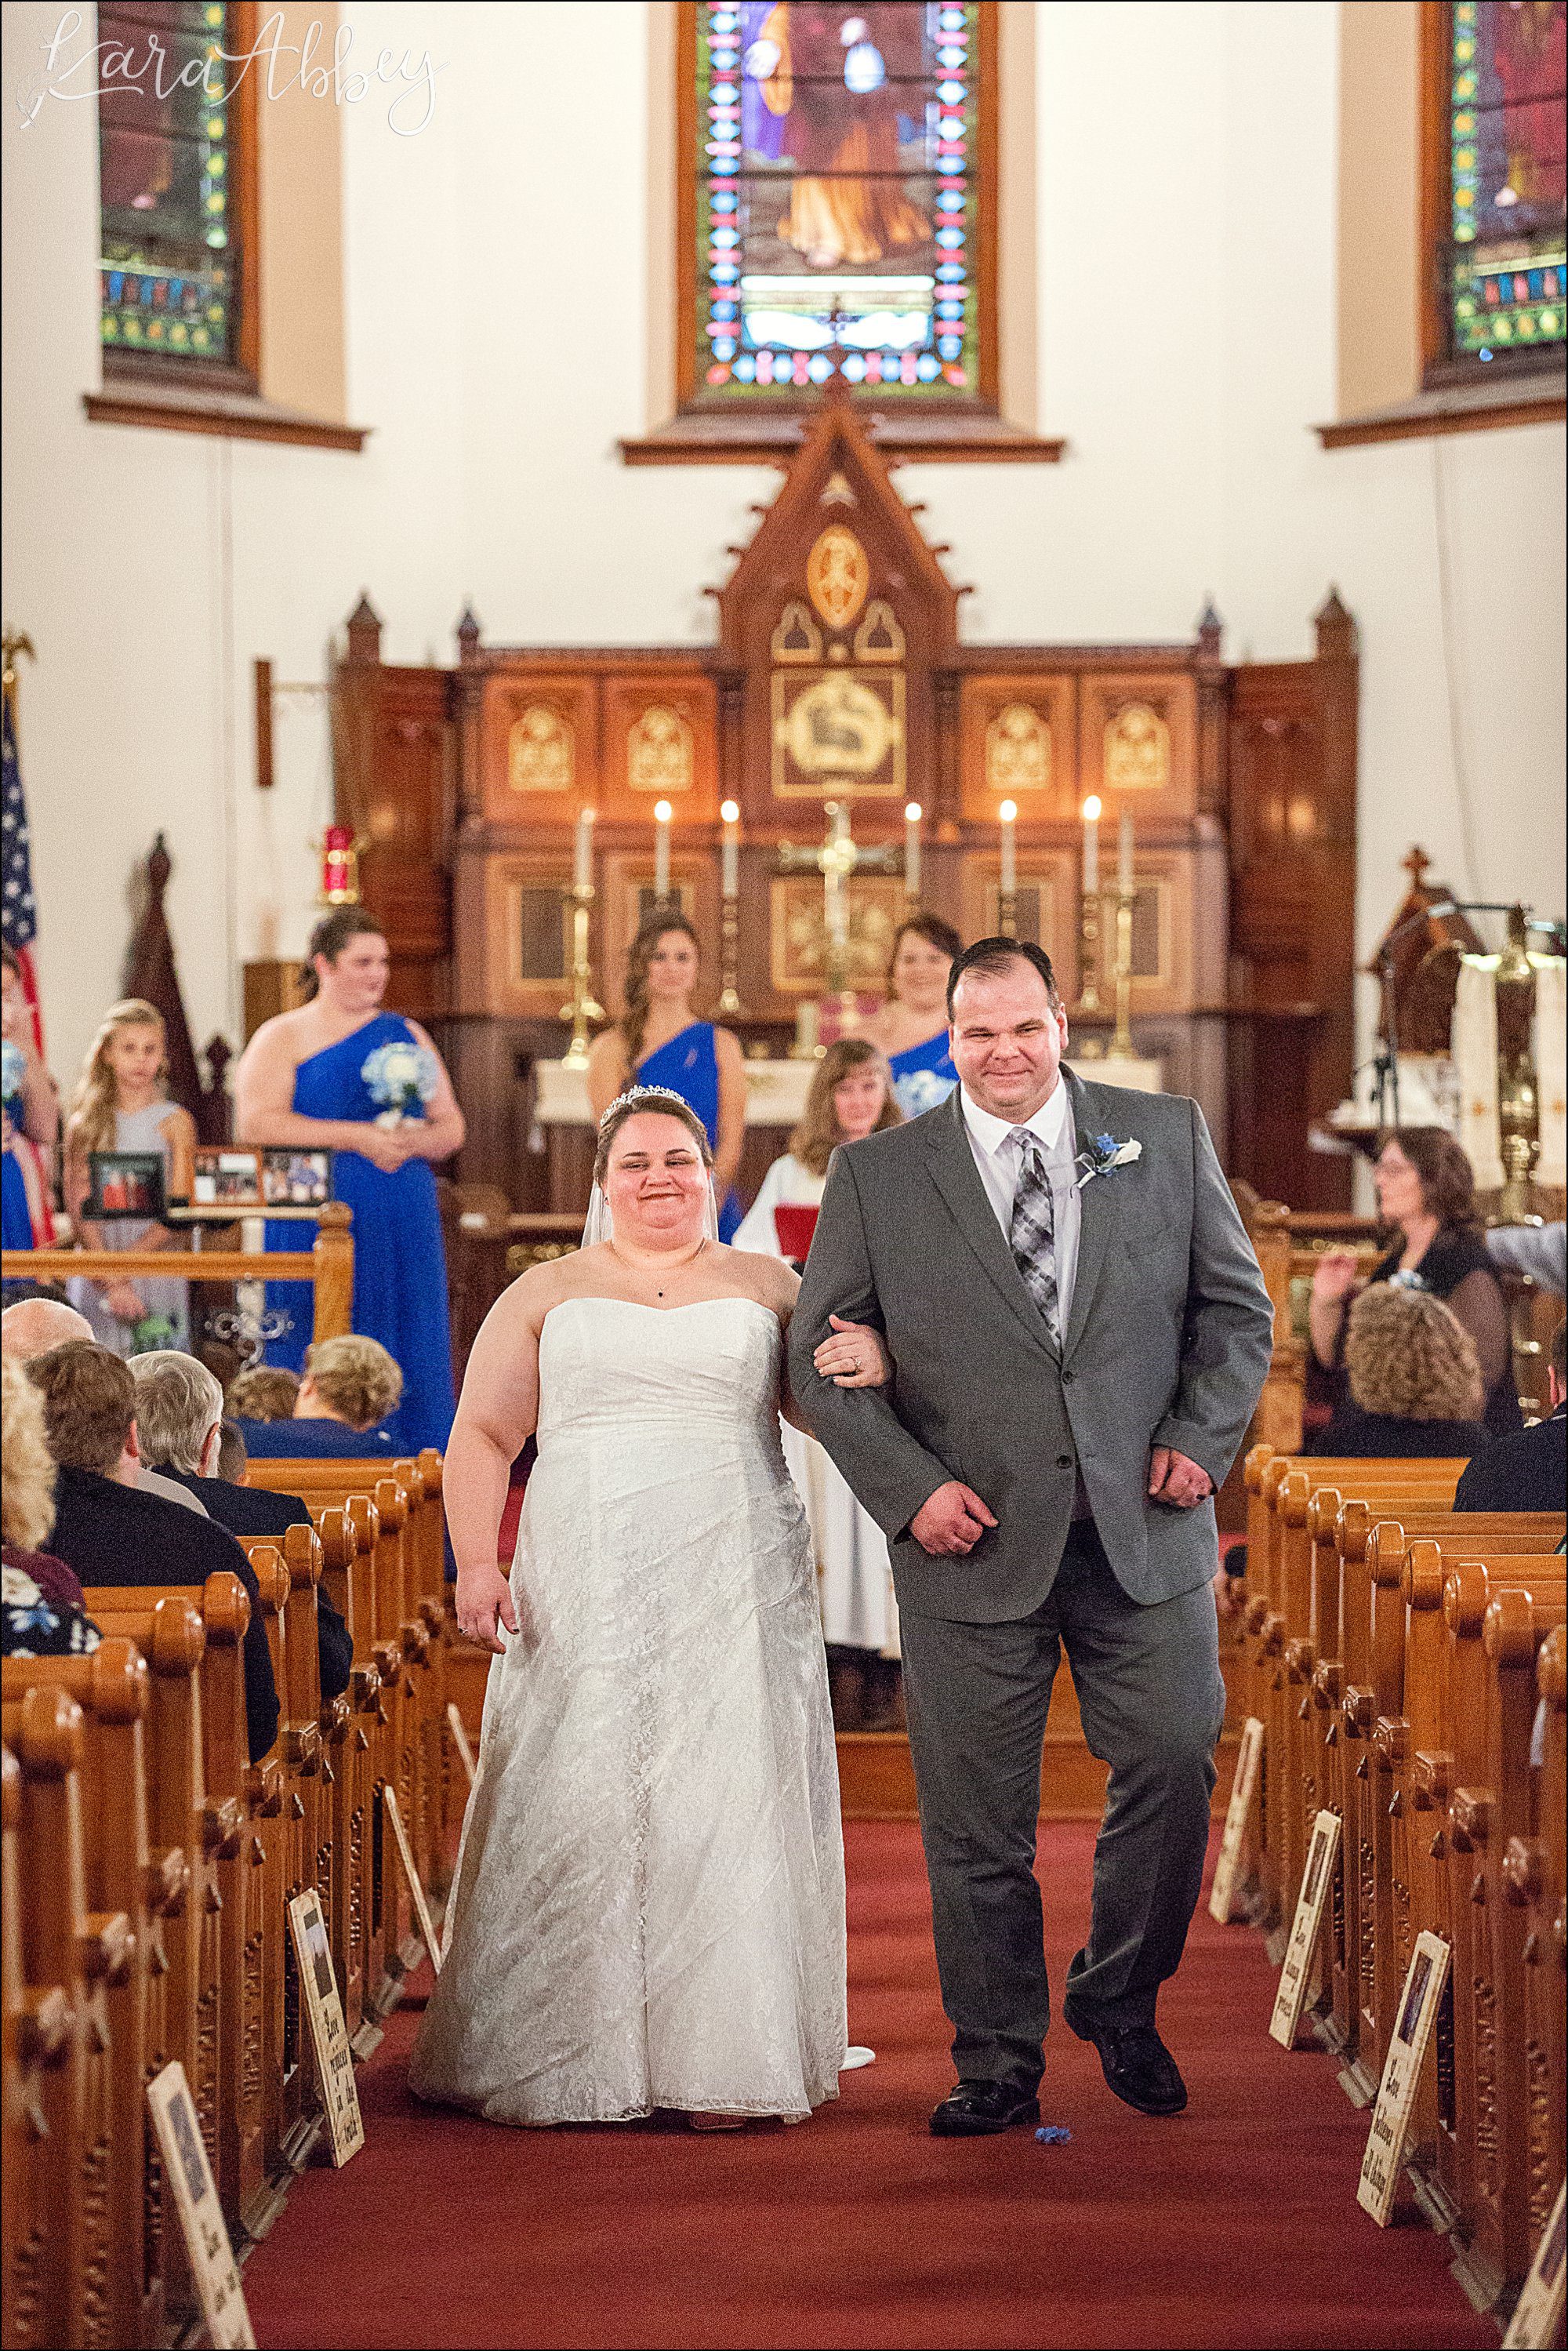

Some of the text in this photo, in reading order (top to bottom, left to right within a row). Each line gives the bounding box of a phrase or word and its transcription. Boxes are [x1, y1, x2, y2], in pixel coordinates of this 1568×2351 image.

[323, 2008, 339, 2043] Love
[1385, 2058, 1400, 2099] Love
[1373, 2103, 1394, 2147] believes
[1362, 2149, 1386, 2207] all things
